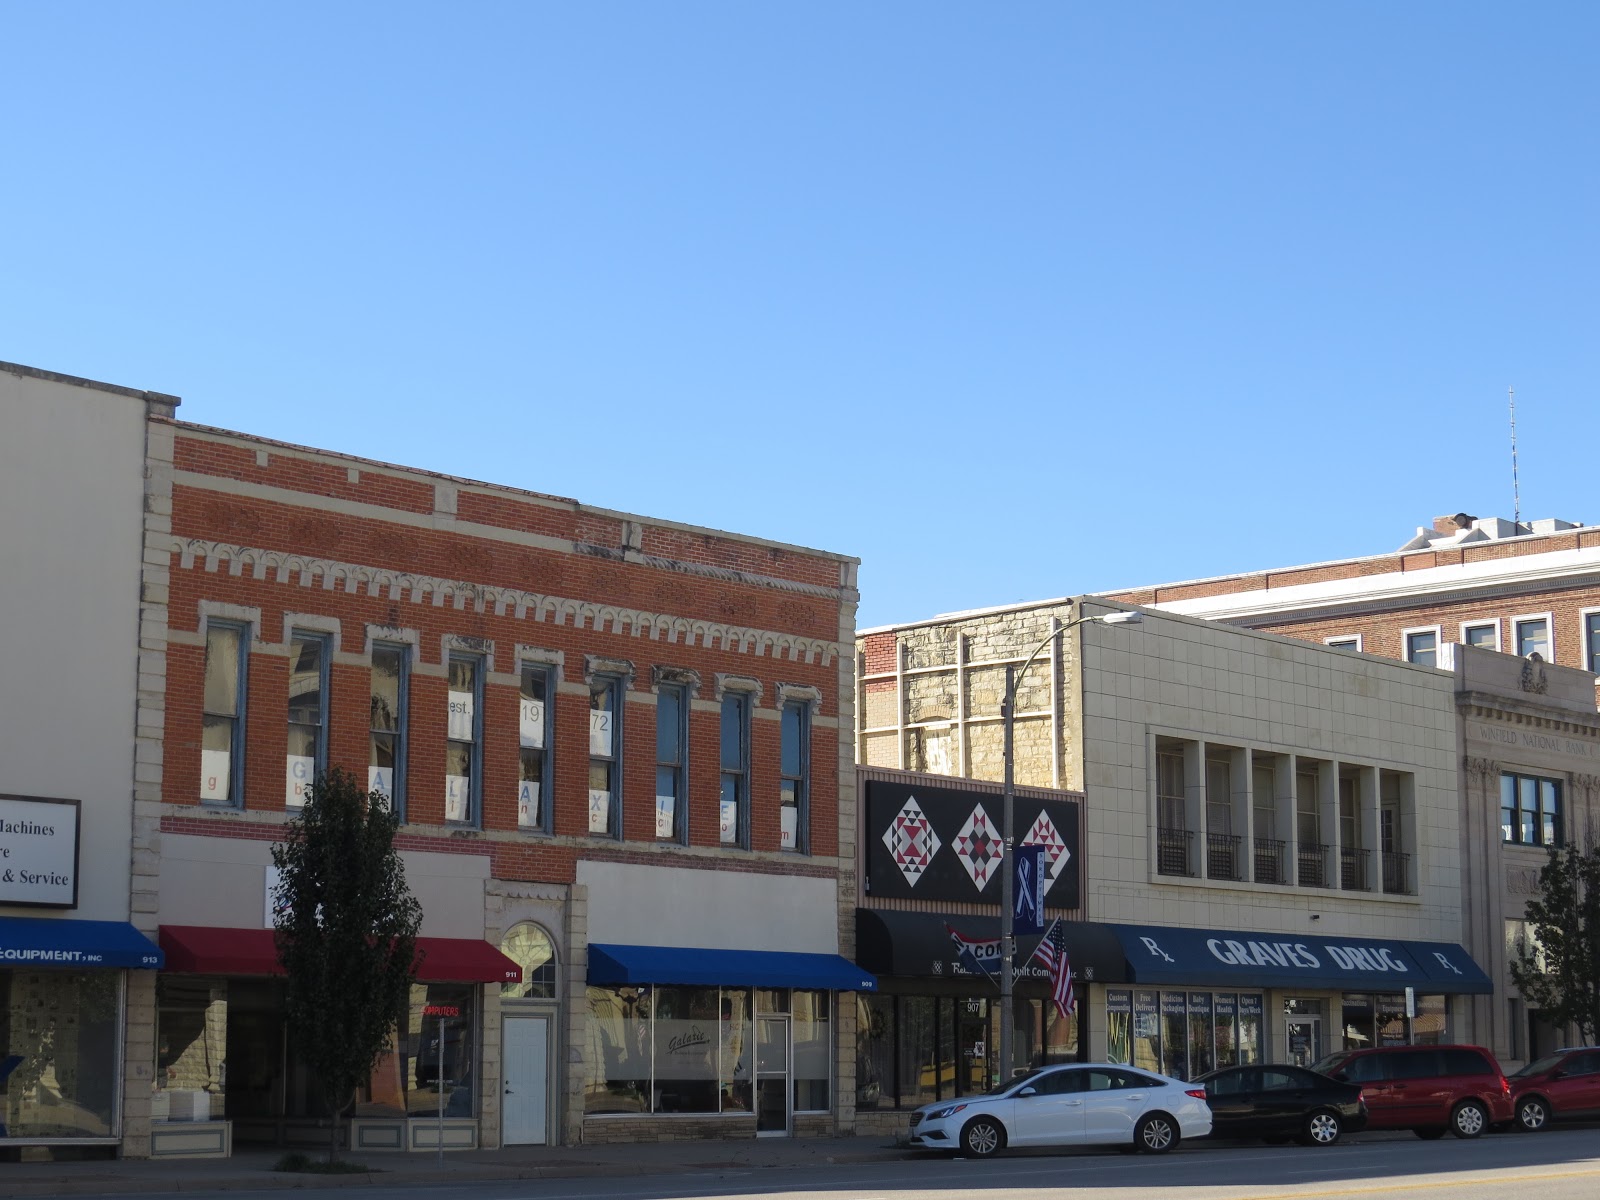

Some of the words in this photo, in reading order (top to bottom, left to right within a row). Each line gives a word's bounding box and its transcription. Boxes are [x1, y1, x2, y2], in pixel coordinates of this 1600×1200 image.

[449, 701, 470, 714] est.
[522, 704, 540, 722] 19
[592, 713, 608, 731] 72
[1479, 726, 1517, 744] WINFIELD
[1522, 733, 1561, 751] NATIONAL
[1566, 741, 1586, 756] BANK
[20, 870, 69, 886] Service
[142, 956, 158, 964] 913
[1206, 938, 1320, 969] GRAVES
[1324, 945, 1408, 972] DRUG
[1139, 994, 1151, 1002] Free
[1161, 994, 1184, 1003] Medicine
[1192, 995, 1204, 1004] Baby
[1241, 996, 1254, 1006] Open
[967, 1002, 979, 1012] 907
[1135, 1003, 1156, 1013] Delivery
[1188, 1005, 1210, 1014] Boutique
[1216, 1005, 1233, 1013] Health
